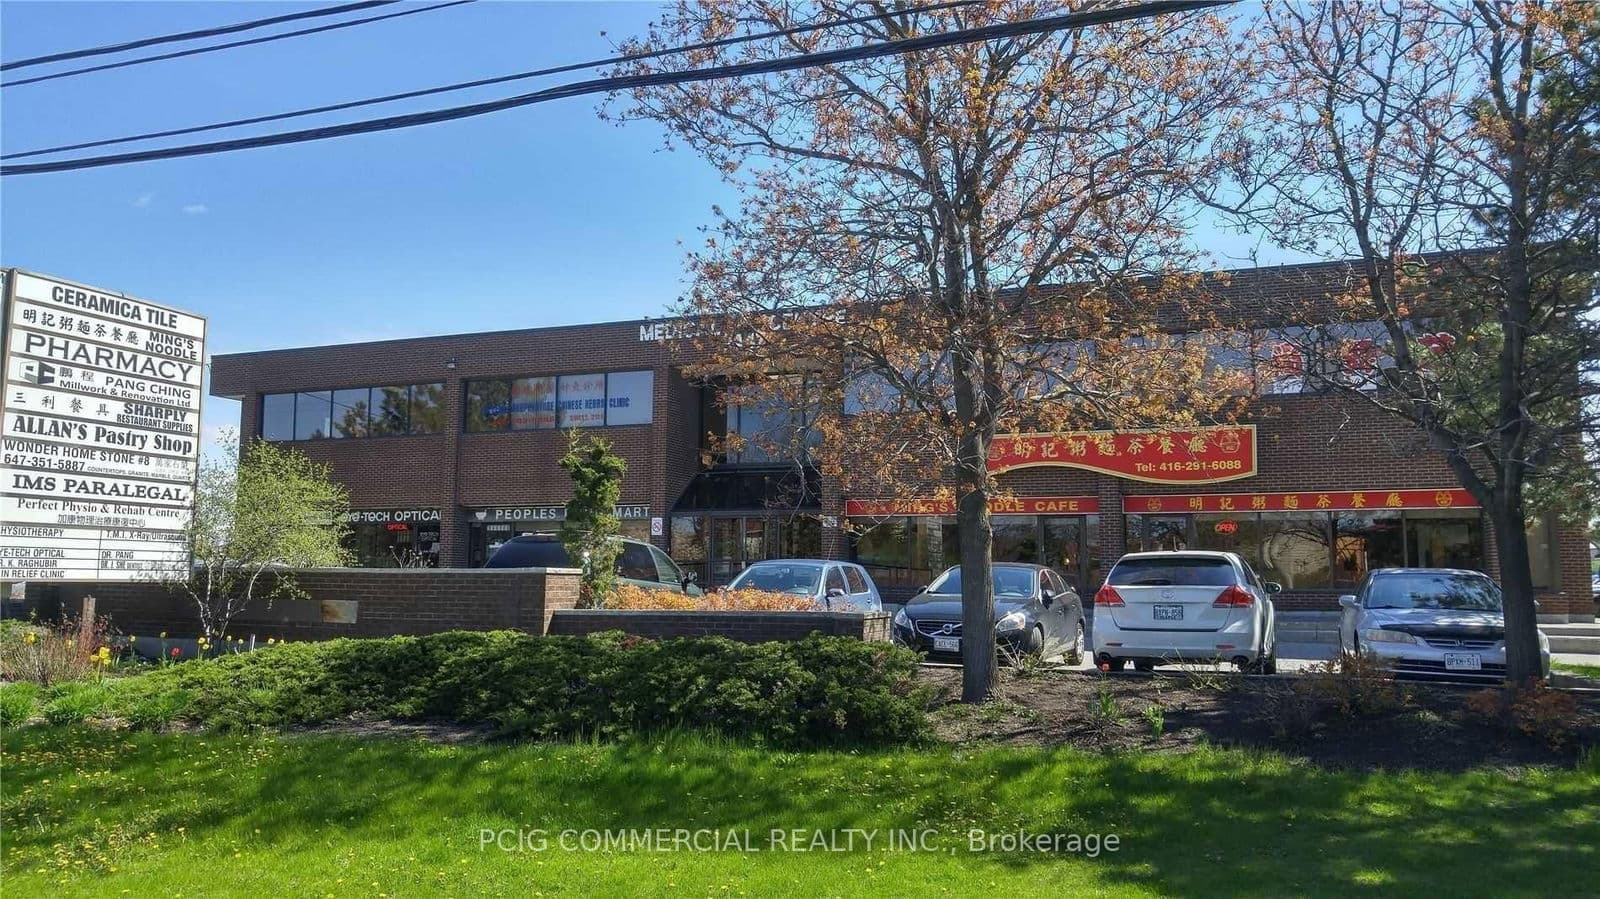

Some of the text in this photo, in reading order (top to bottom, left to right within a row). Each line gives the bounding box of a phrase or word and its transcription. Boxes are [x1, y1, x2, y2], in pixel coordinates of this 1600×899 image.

[52, 286, 178, 329] CERAMICA TILE
[149, 331, 194, 350] MING'S
[25, 332, 193, 382] PHARMACY
[145, 340, 197, 361] NOODLE
[59, 380, 191, 408] Millwork & Renovation Ltd
[105, 376, 191, 400] PANG CHING
[123, 403, 188, 423] SHARPLY
[116, 413, 193, 433] RESTAURANT SUPPLIES
[13, 415, 192, 455] ALLAN'S Pastry Shop
[4, 439, 150, 466] WONDER HOME STONE #8
[4, 453, 85, 472] 647-351-5887
[1135, 460, 1241, 472] Tel: 416-291-6088
[12, 474, 186, 501] IMS PARALEGAL
[18, 499, 180, 518] Perfect Physio & Rehab Centre
[495, 508, 556, 519] PEOPLES
[612, 506, 650, 517] MART
[1035, 500, 1079, 511] CAFE
[1216, 523, 1236, 532] OPEN
[33, 549, 65, 558] OPTICAL
[115, 551, 134, 560] PANG
[17, 560, 58, 568] RAGHUBIR
[12, 570, 38, 578] RELIEF
[39, 570, 65, 578] CLINIC
